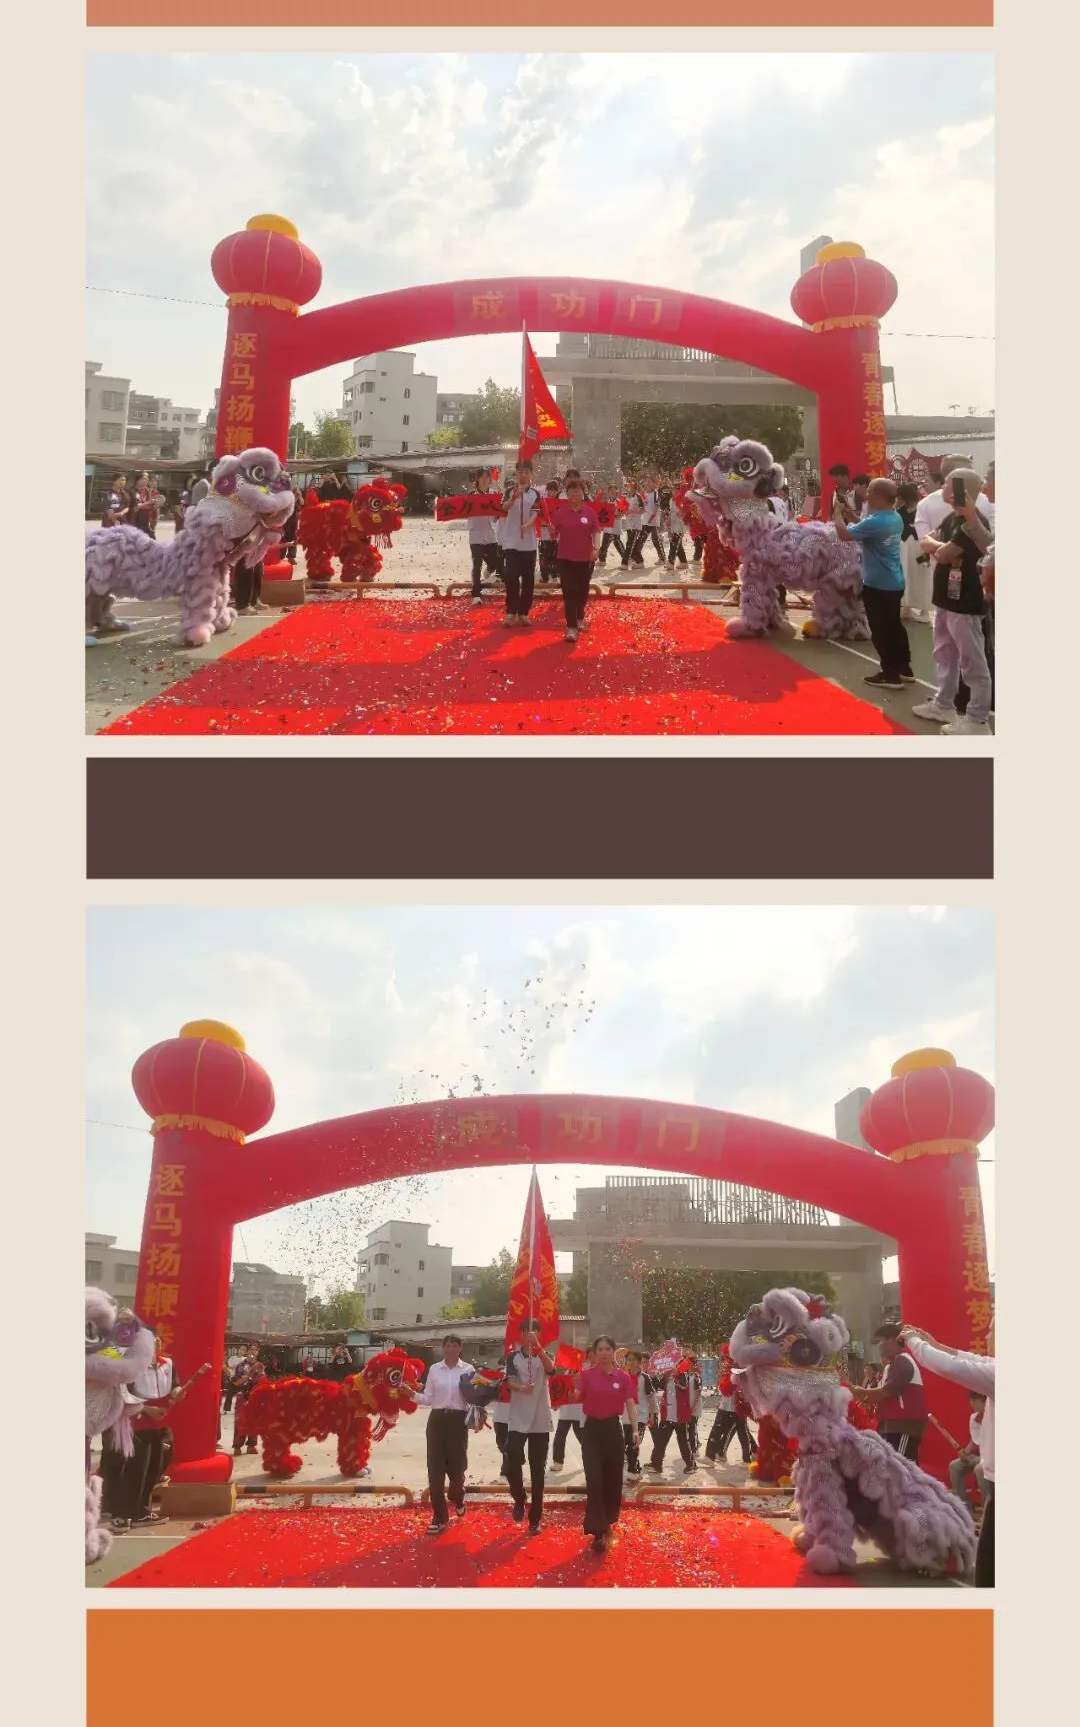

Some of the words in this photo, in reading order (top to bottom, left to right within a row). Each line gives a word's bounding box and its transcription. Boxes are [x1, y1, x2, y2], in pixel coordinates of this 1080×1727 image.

[472, 288, 662, 324] 成功门
[224, 333, 257, 452] 逐马扬鞭
[458, 1108, 699, 1152] 成功门
